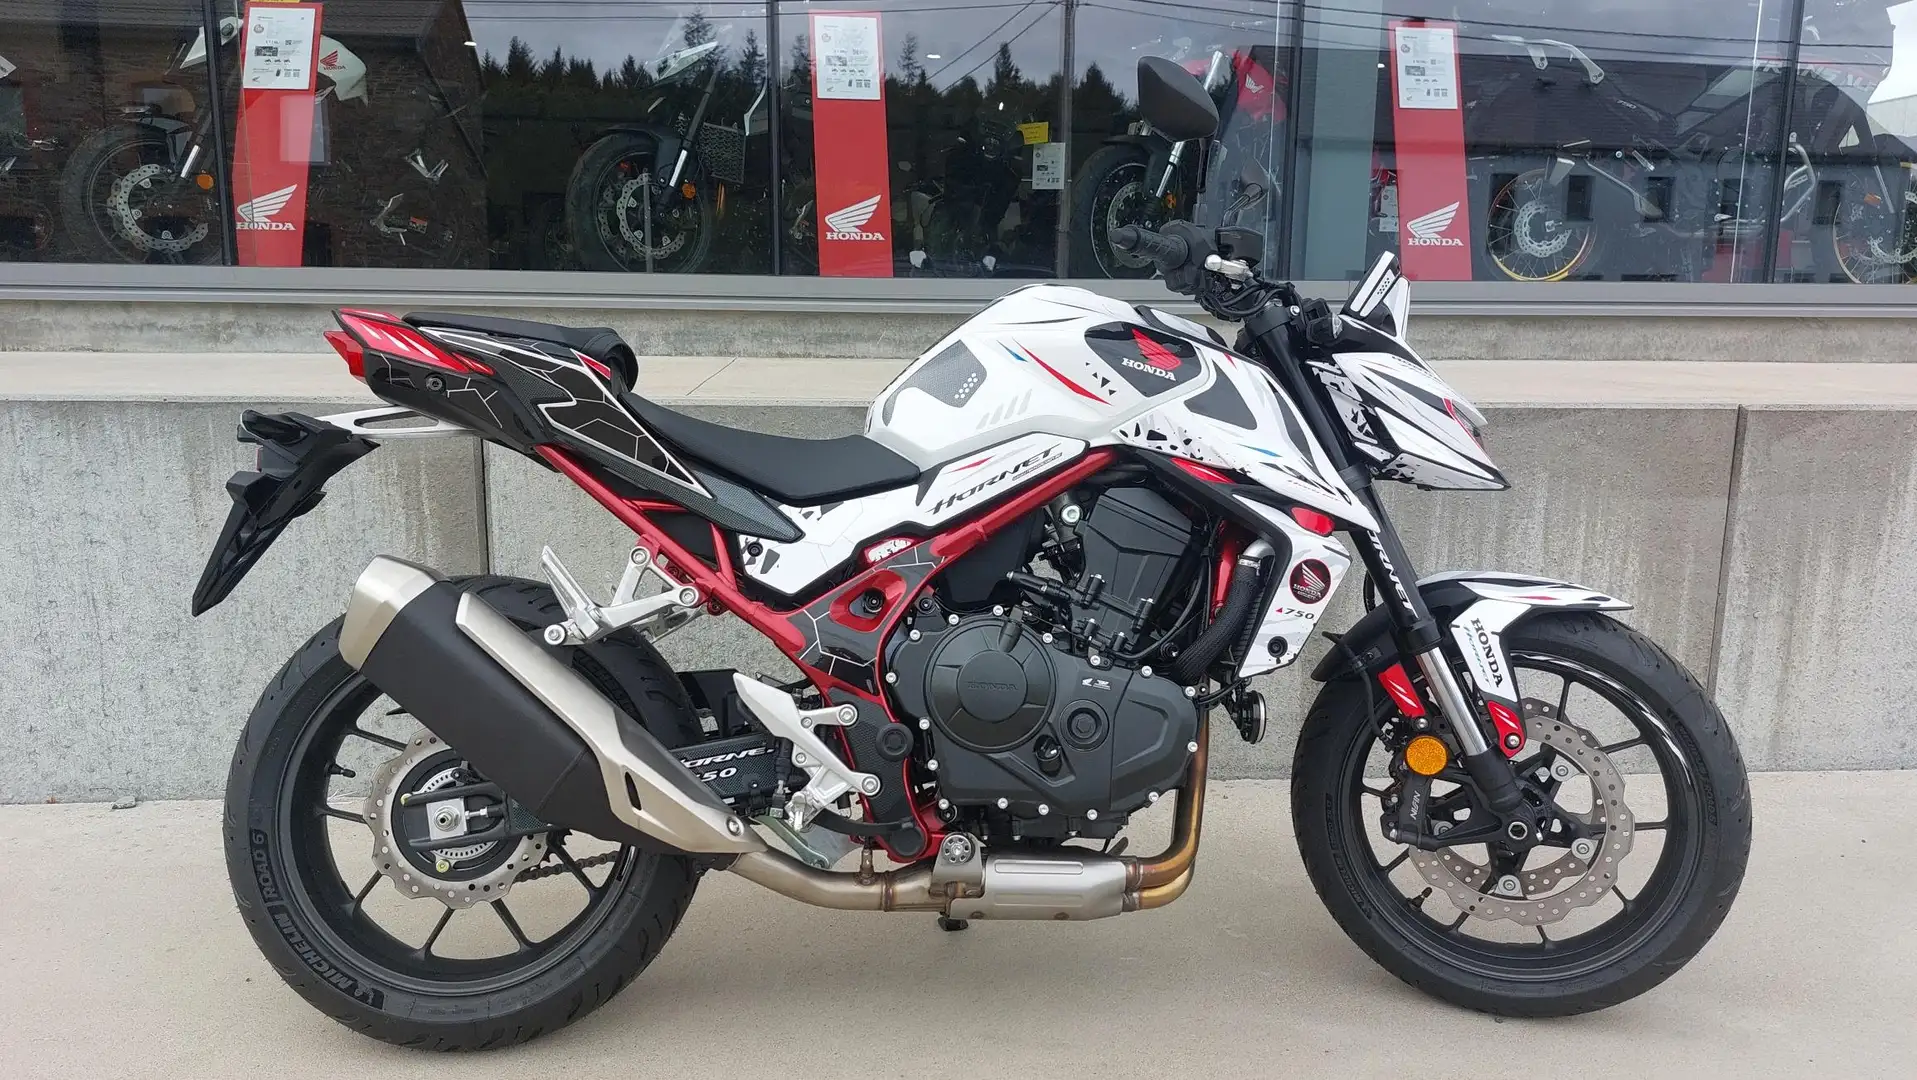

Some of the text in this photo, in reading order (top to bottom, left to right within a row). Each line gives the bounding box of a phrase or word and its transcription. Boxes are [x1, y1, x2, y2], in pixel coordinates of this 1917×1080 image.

[236, 222, 296, 231] HONDA
[826, 232, 885, 240] HONDA
[1408, 238, 1464, 246] HONDA
[1121, 358, 1177, 381] HONDA
[924, 442, 1062, 515] HORNET
[1366, 530, 1419, 619] ORNET
[1293, 584, 1322, 598] HONDA
[1285, 607, 1314, 619] 750
[1471, 618, 1503, 688] HONDA
[680, 746, 775, 768] ORNE
[696, 767, 737, 782] 50
[252, 832, 355, 990] MICHELIN ROAD 6
